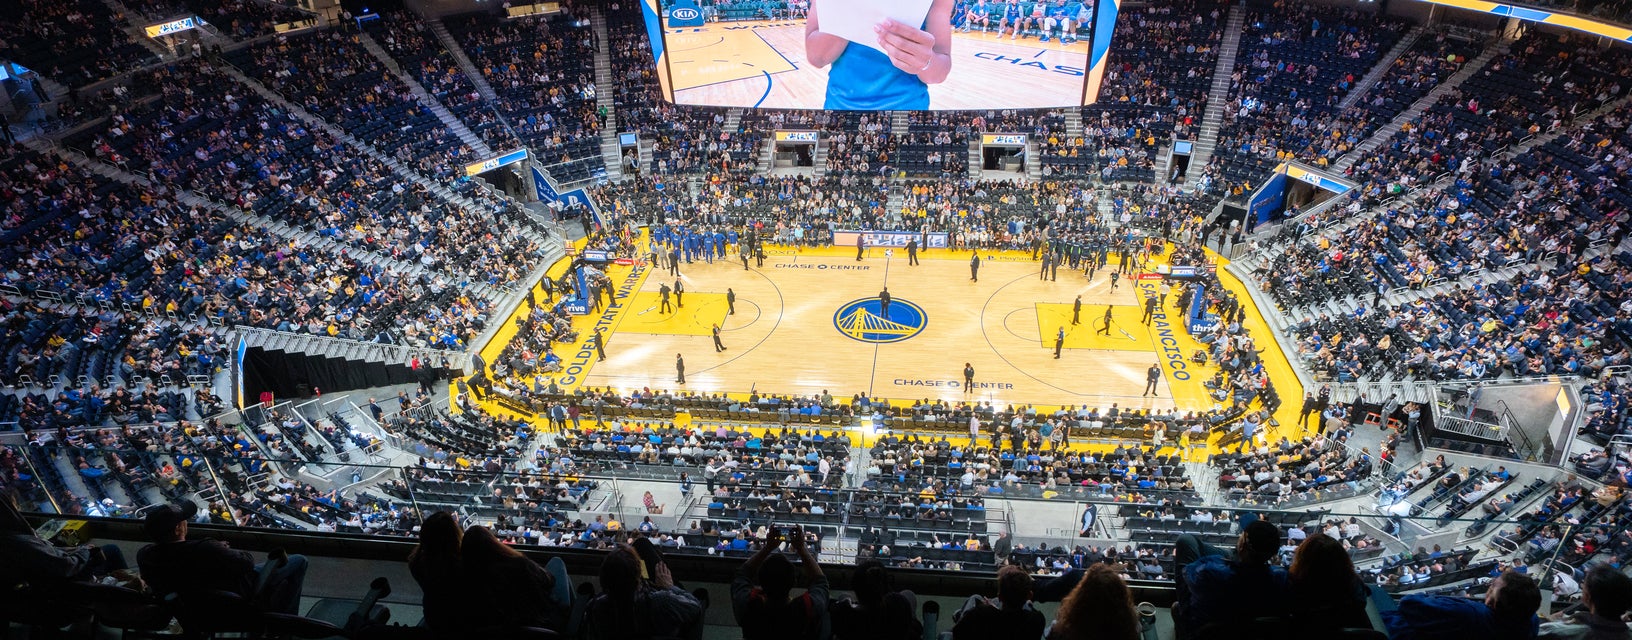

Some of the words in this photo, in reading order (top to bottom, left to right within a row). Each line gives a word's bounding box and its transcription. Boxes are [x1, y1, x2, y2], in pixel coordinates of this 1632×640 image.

[676, 8, 696, 18] KIA
[974, 52, 1084, 76] CHAS
[568, 303, 586, 312] rive
[596, 301, 624, 333] STATE
[894, 379, 944, 387] CHASE
